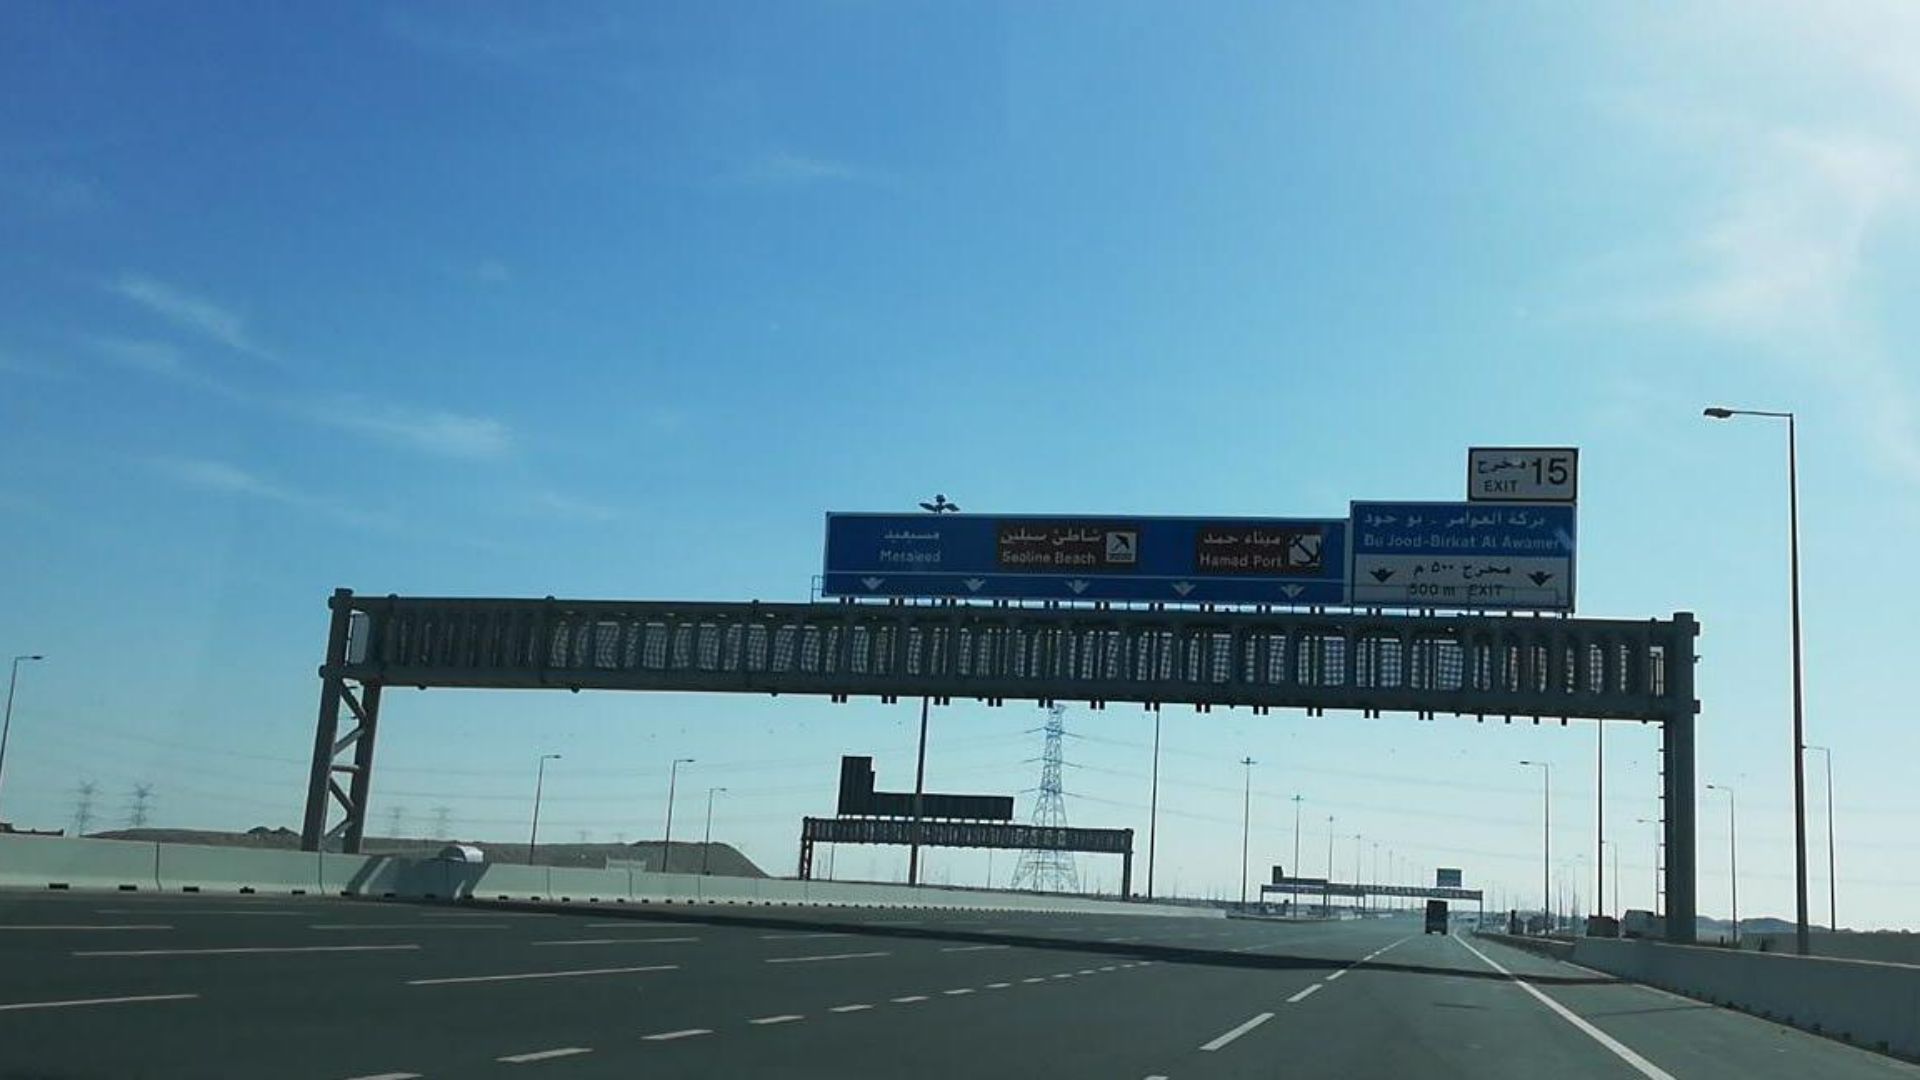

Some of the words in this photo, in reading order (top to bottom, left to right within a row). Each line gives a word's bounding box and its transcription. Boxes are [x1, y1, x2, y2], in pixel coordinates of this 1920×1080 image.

[1532, 458, 1568, 485] 15
[1484, 479, 1518, 492] EXIT
[1482, 535, 1497, 548] Al
[1054, 551, 1096, 565] Beach
[1200, 552, 1248, 567] Hamad
[1253, 554, 1282, 568] Port
[1409, 584, 1439, 596] 500
[1442, 586, 1456, 596] m
[1468, 584, 1504, 597] EXIT
